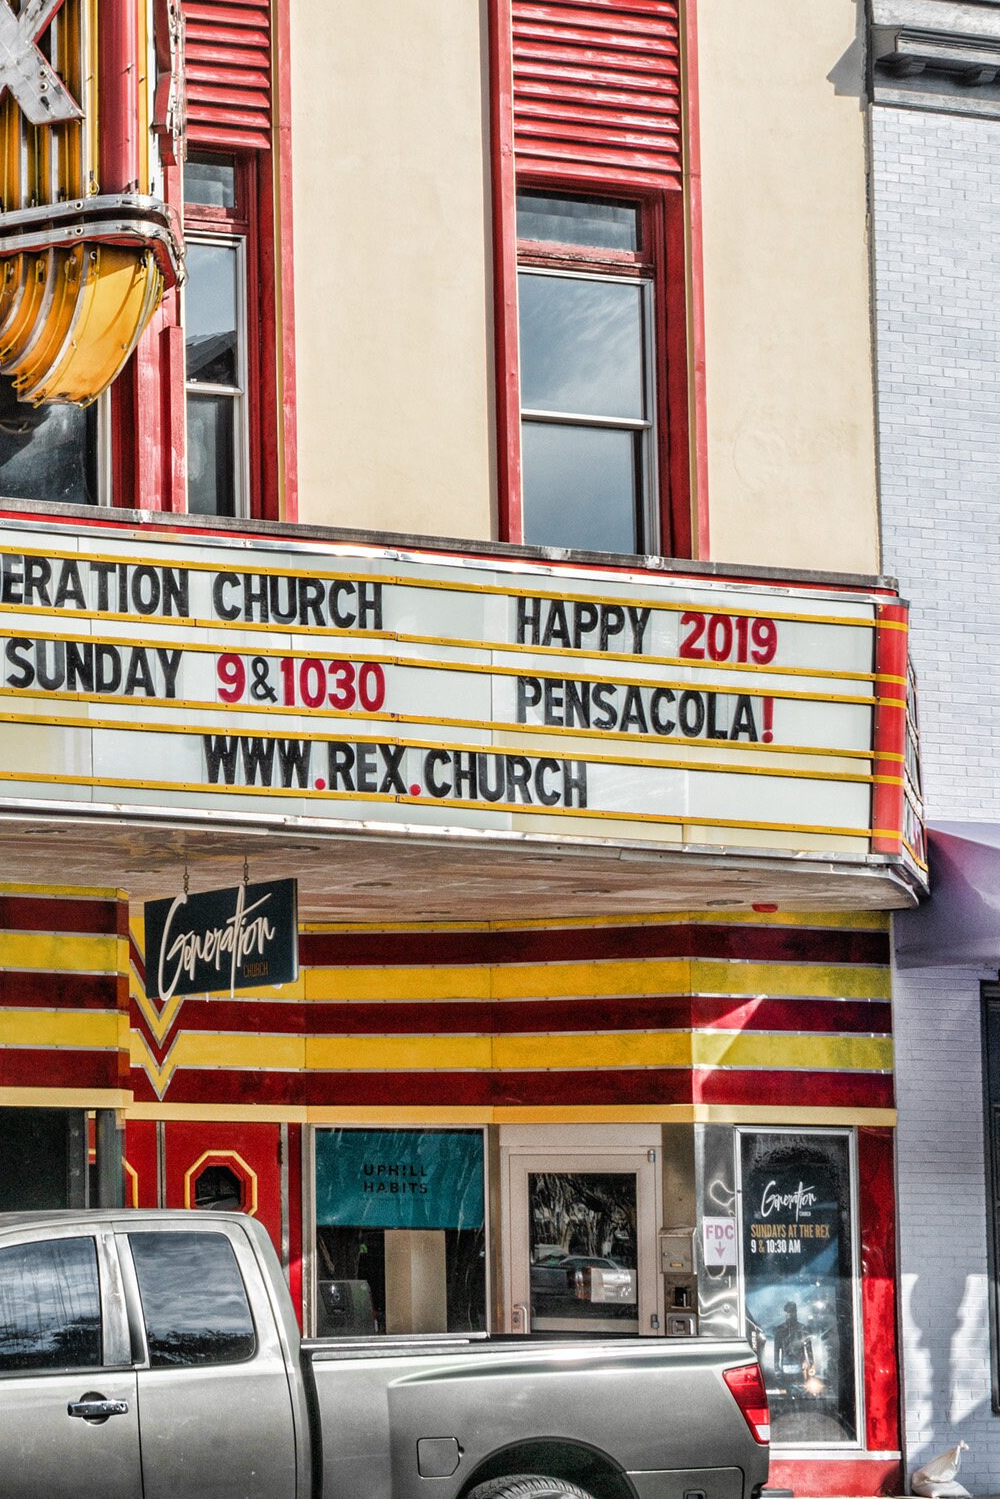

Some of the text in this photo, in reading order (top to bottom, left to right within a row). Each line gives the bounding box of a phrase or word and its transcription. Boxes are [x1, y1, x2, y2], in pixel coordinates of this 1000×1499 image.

[212, 571, 383, 630] CHURCH
[516, 596, 778, 665] HAPPY 2019
[5, 637, 183, 698] SUNDAY
[517, 675, 774, 743] PENSACOLA!
[203, 734, 589, 809] WWW.REX.CHURCH
[158, 884, 276, 1002] Generation
[363, 1165, 428, 1177] UPHILL
[363, 1182, 428, 1194] HABITS
[761, 1181, 817, 1222] Generation
[705, 1224, 735, 1240] FDC
[750, 1223, 830, 1238] SUNDAYS AT THE REX
[750, 1239, 801, 1254] 9 & 10:30 AM
